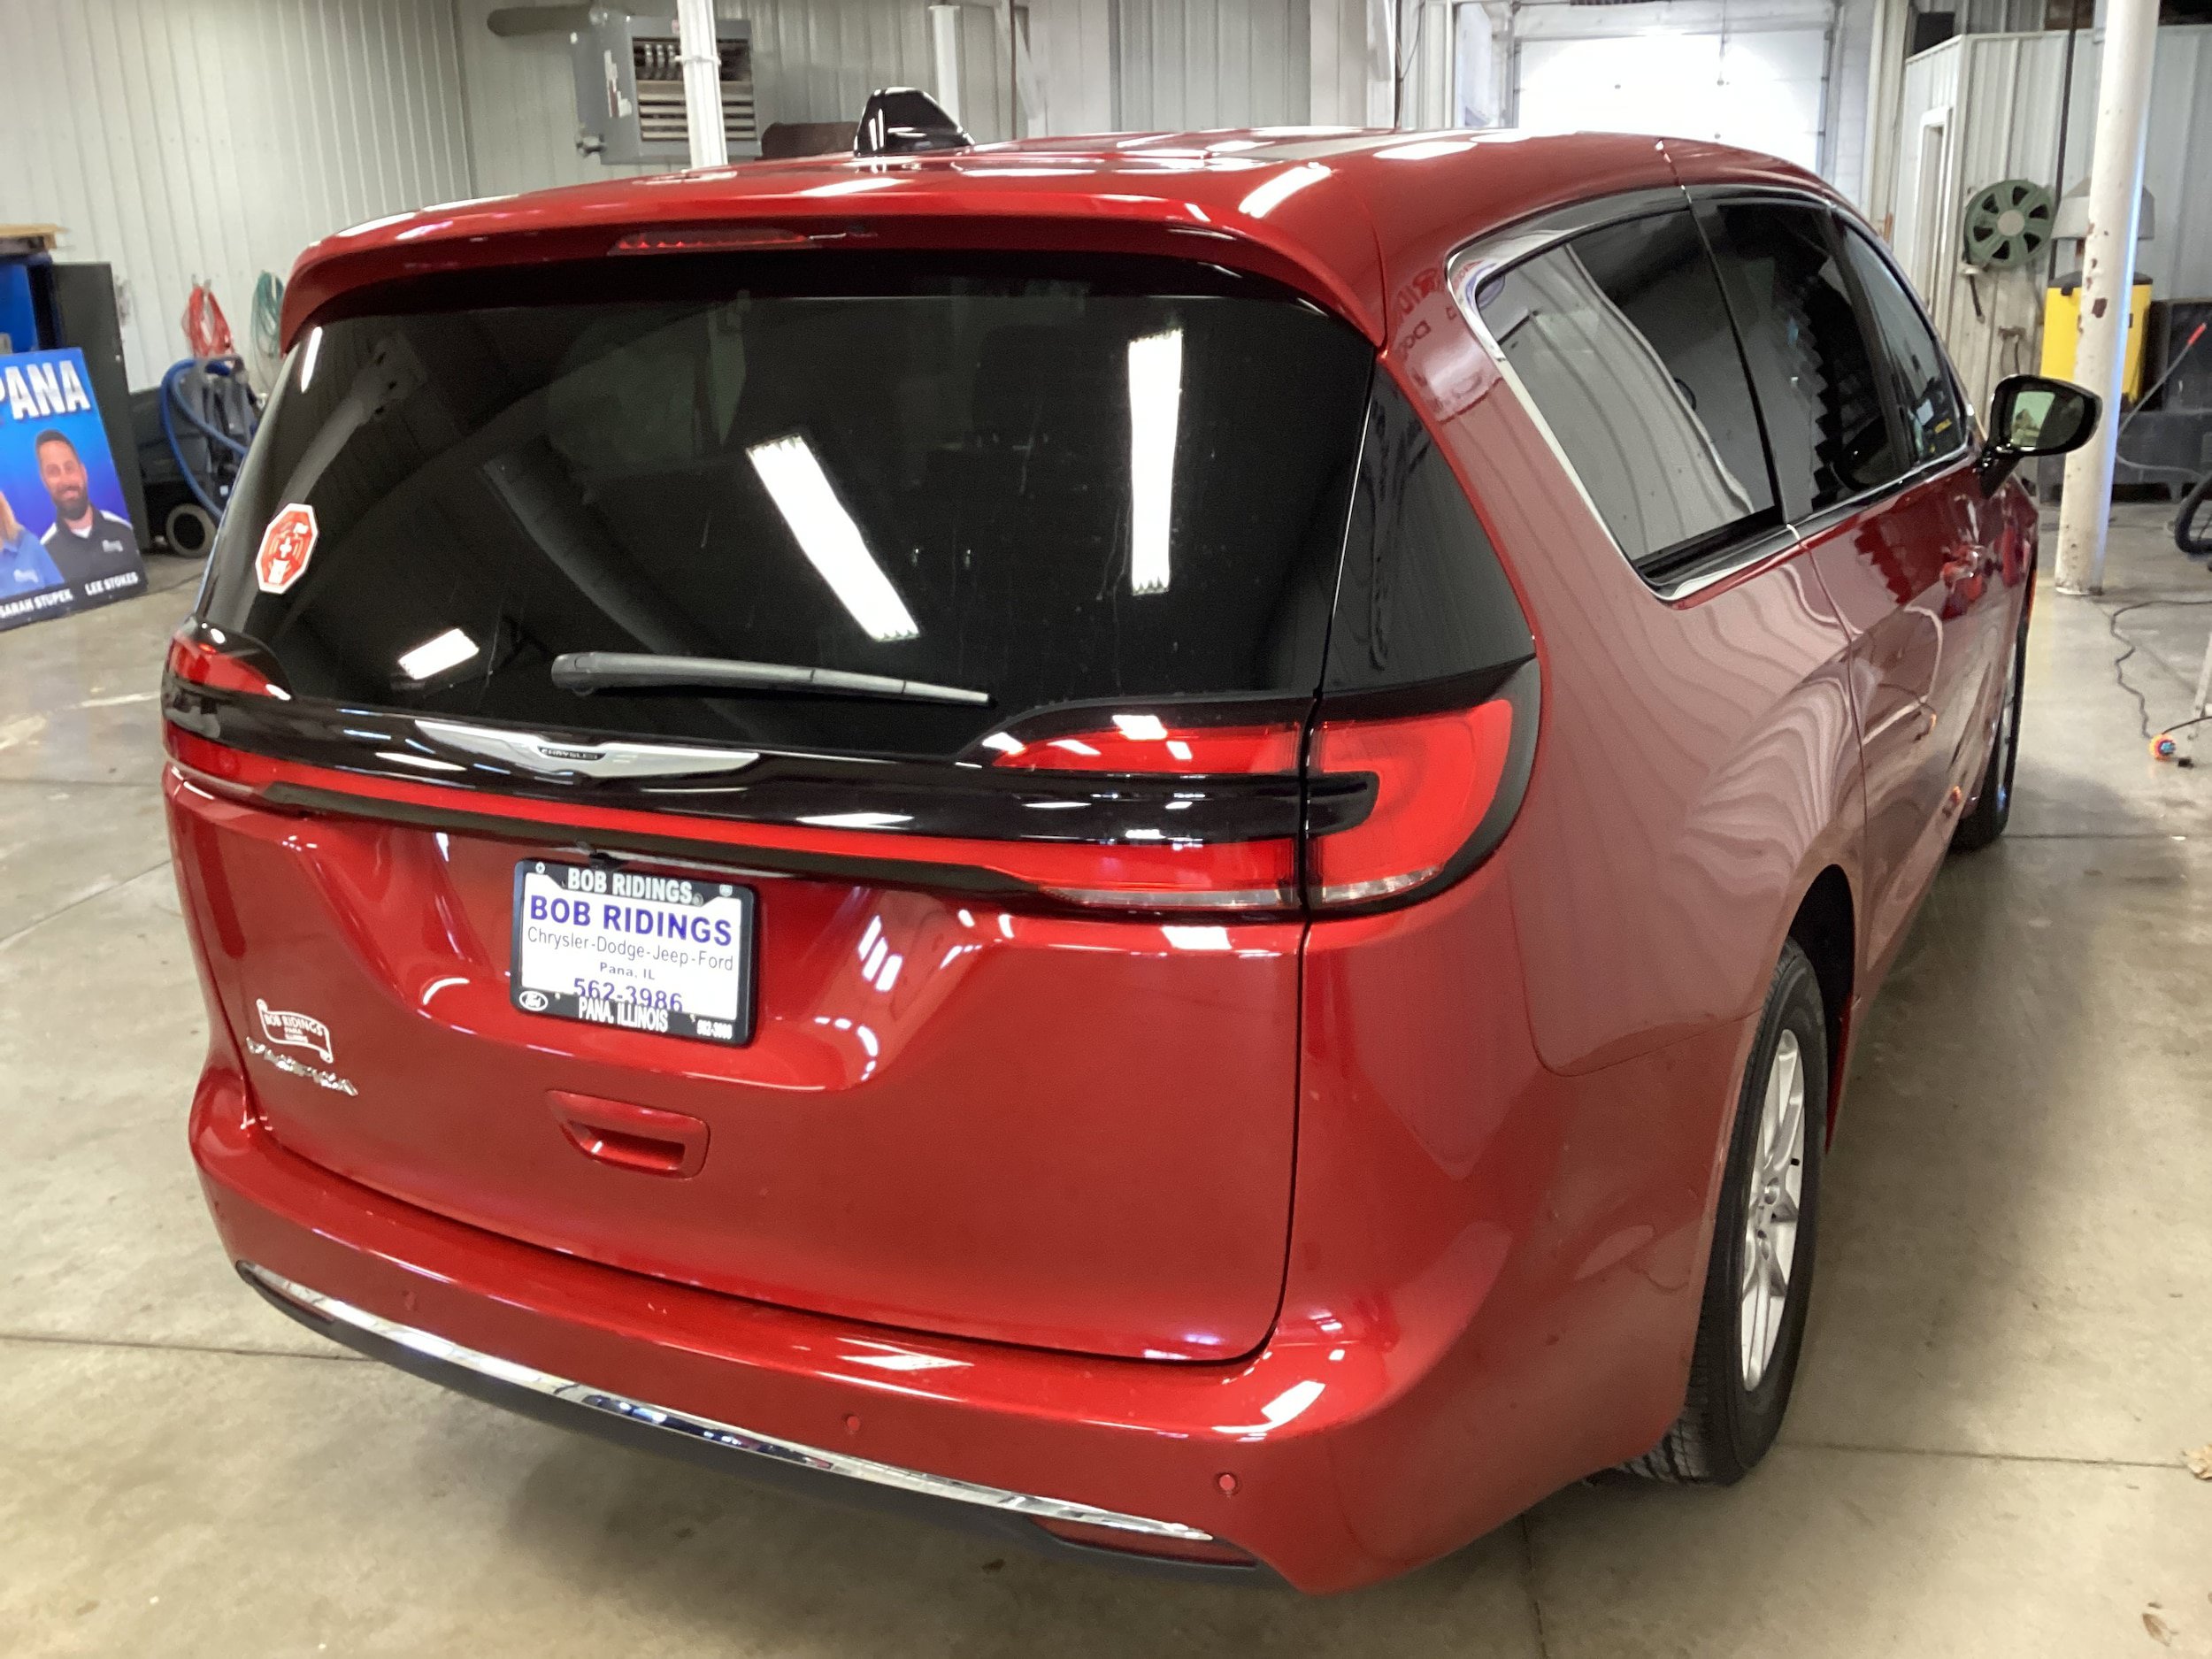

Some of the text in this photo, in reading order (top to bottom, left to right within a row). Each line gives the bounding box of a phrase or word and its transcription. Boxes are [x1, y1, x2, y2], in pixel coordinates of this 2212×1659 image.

[85, 572, 139, 596] LEE STOKES
[567, 867, 693, 904] BOB RIDINGS
[530, 895, 732, 947] BOB RIDINGS
[527, 926, 733, 972] Chrysler-Dodge-Jeep-Ford
[643, 969, 656, 980] IL
[573, 978, 683, 1012] 562-3986
[281, 1015, 323, 1037] RIDINGS
[617, 1001, 669, 1033] ILLINOIS
